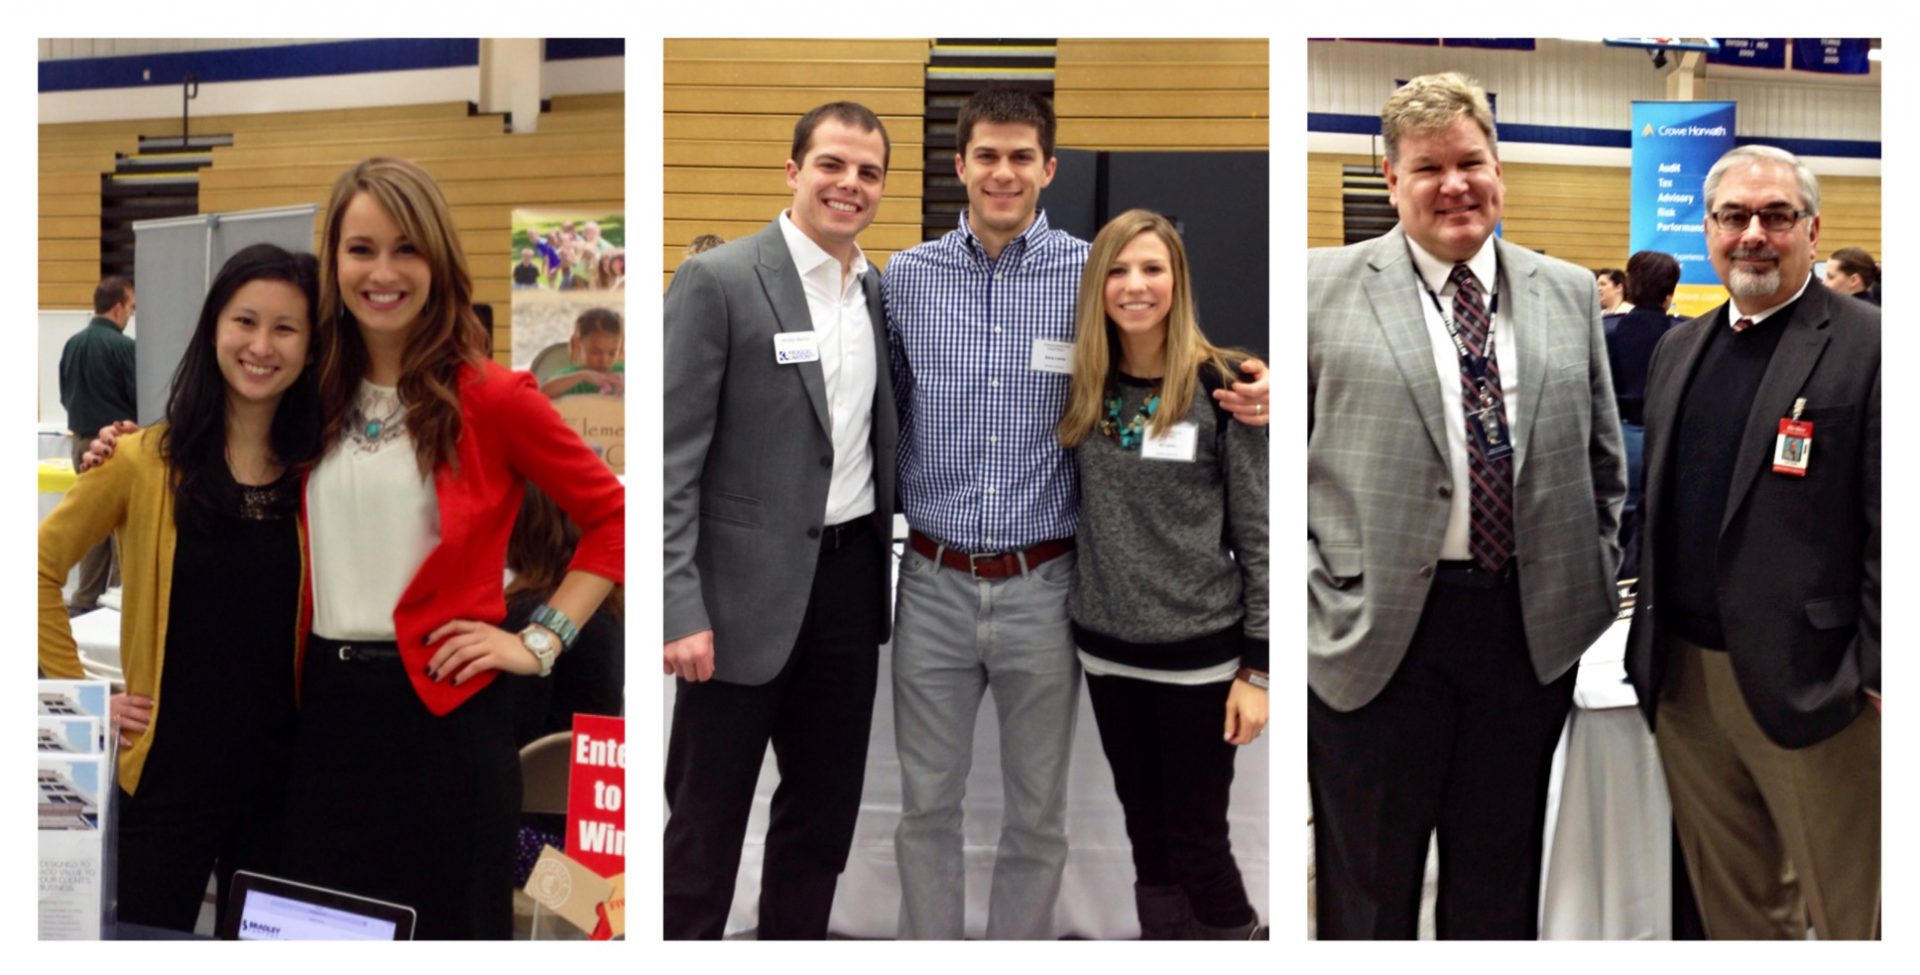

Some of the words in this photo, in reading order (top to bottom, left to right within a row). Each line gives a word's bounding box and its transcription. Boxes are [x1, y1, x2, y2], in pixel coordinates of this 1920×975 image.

[1658, 125, 1687, 136] Crowe
[1688, 126, 1727, 137] Horwath
[1658, 163, 1681, 173] Audit
[1658, 178, 1673, 188] Tax
[1657, 193, 1695, 205] Advisory
[1657, 208, 1676, 218] Risk
[571, 416, 625, 437] leme
[594, 780, 622, 812] to
[249, 921, 281, 934] BRADLEY
